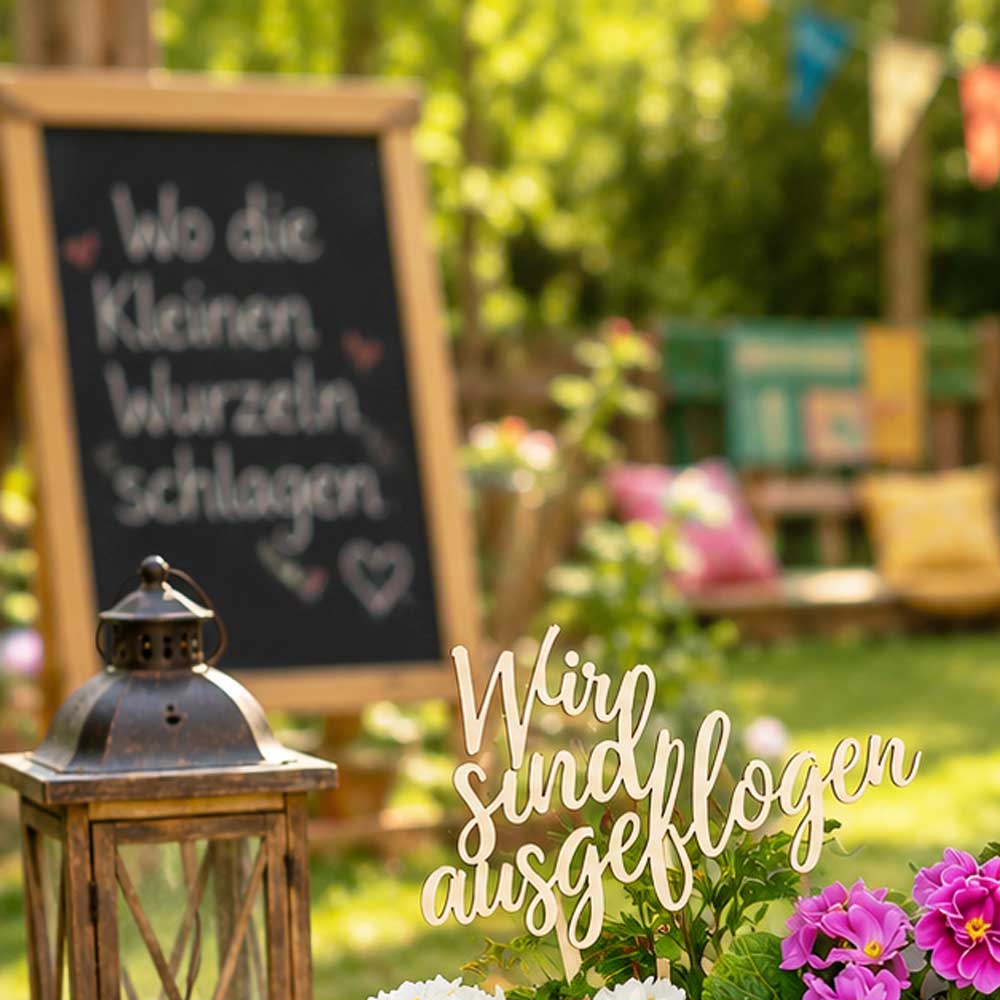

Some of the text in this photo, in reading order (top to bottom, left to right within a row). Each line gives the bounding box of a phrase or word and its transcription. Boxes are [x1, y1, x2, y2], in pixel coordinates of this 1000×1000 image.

[111, 182, 324, 263] Wo die
[91, 272, 322, 352] Kleinen
[104, 358, 362, 438] Wurzeln
[110, 442, 386, 558] schlagen
[451, 624, 612, 770] Wir
[452, 663, 660, 866] sind
[420, 709, 922, 951] ausgeflogen
